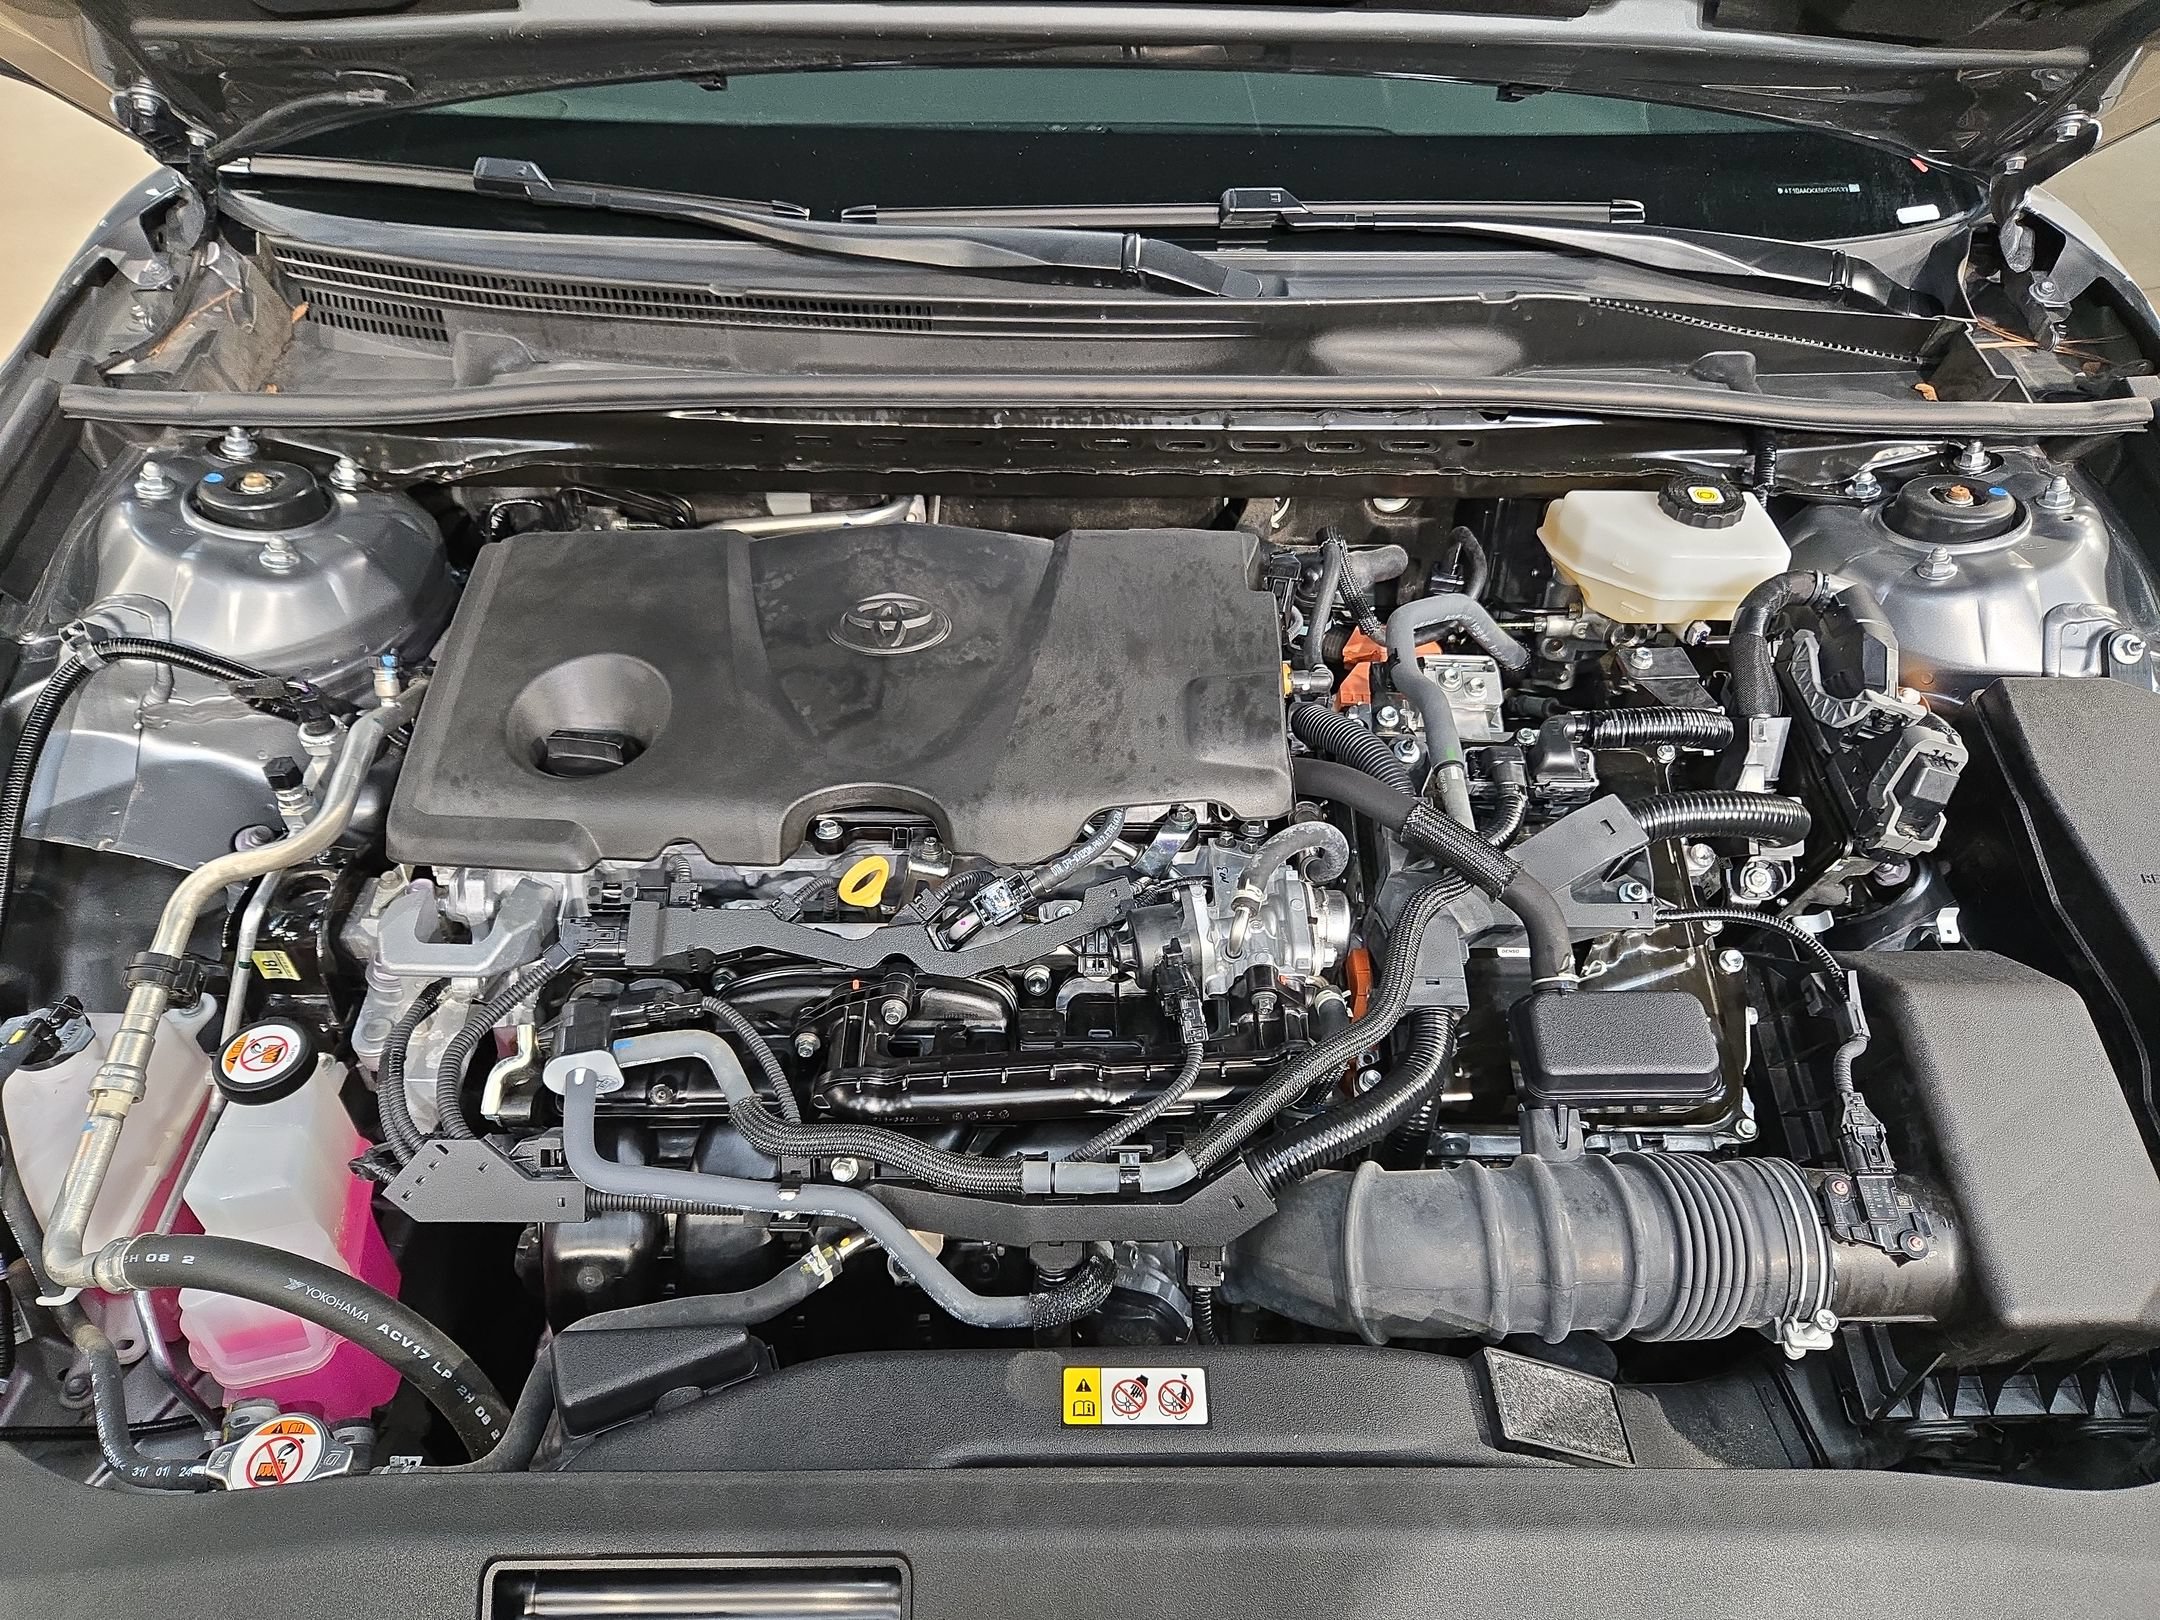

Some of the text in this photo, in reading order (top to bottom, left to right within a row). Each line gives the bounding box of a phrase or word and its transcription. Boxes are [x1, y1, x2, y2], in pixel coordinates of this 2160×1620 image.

[145, 1253, 170, 1263] 08
[181, 1255, 196, 1265] 2
[305, 1285, 370, 1324] YOKOHAMA
[376, 1323, 432, 1360] ACV17
[432, 1361, 453, 1380] LP
